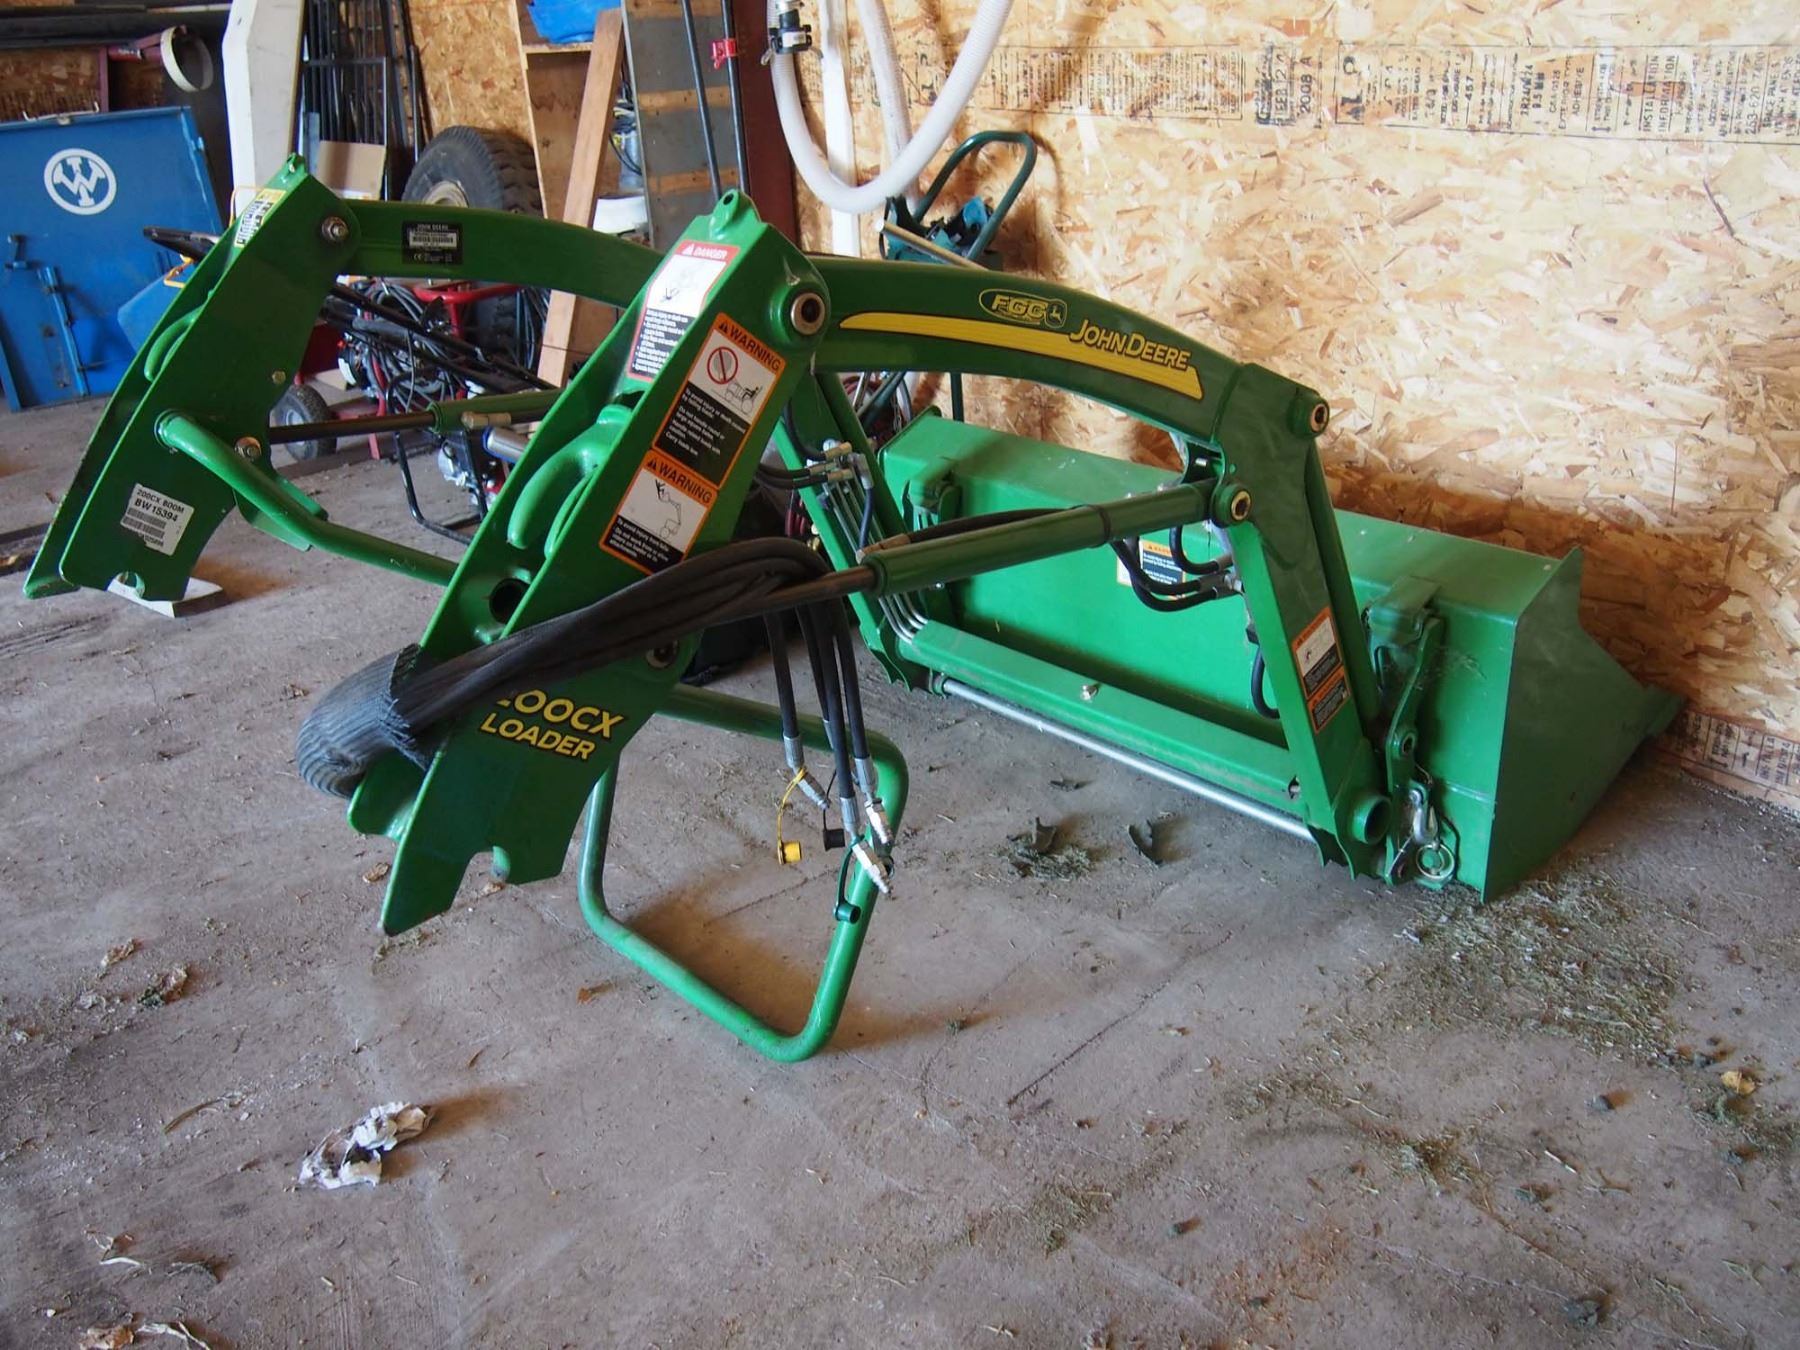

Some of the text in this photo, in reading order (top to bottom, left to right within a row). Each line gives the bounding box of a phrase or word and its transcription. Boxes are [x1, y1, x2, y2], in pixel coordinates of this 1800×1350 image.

[1300, 74, 1313, 114] 2008
[1464, 76, 1474, 101] 457
[1642, 55, 1660, 132] INSTALLATION
[1658, 55, 1675, 133] INFORMATION
[1745, 51, 1767, 134] 253-6207400
[1762, 99, 1776, 128] SPACE
[731, 326, 781, 372] WARNING
[1069, 319, 1191, 371] JOHN DEERE
[659, 461, 713, 505] WARNING
[162, 500, 185, 514] BOOM
[480, 712, 596, 760] LOADER
[497, 689, 624, 738] 00CX
